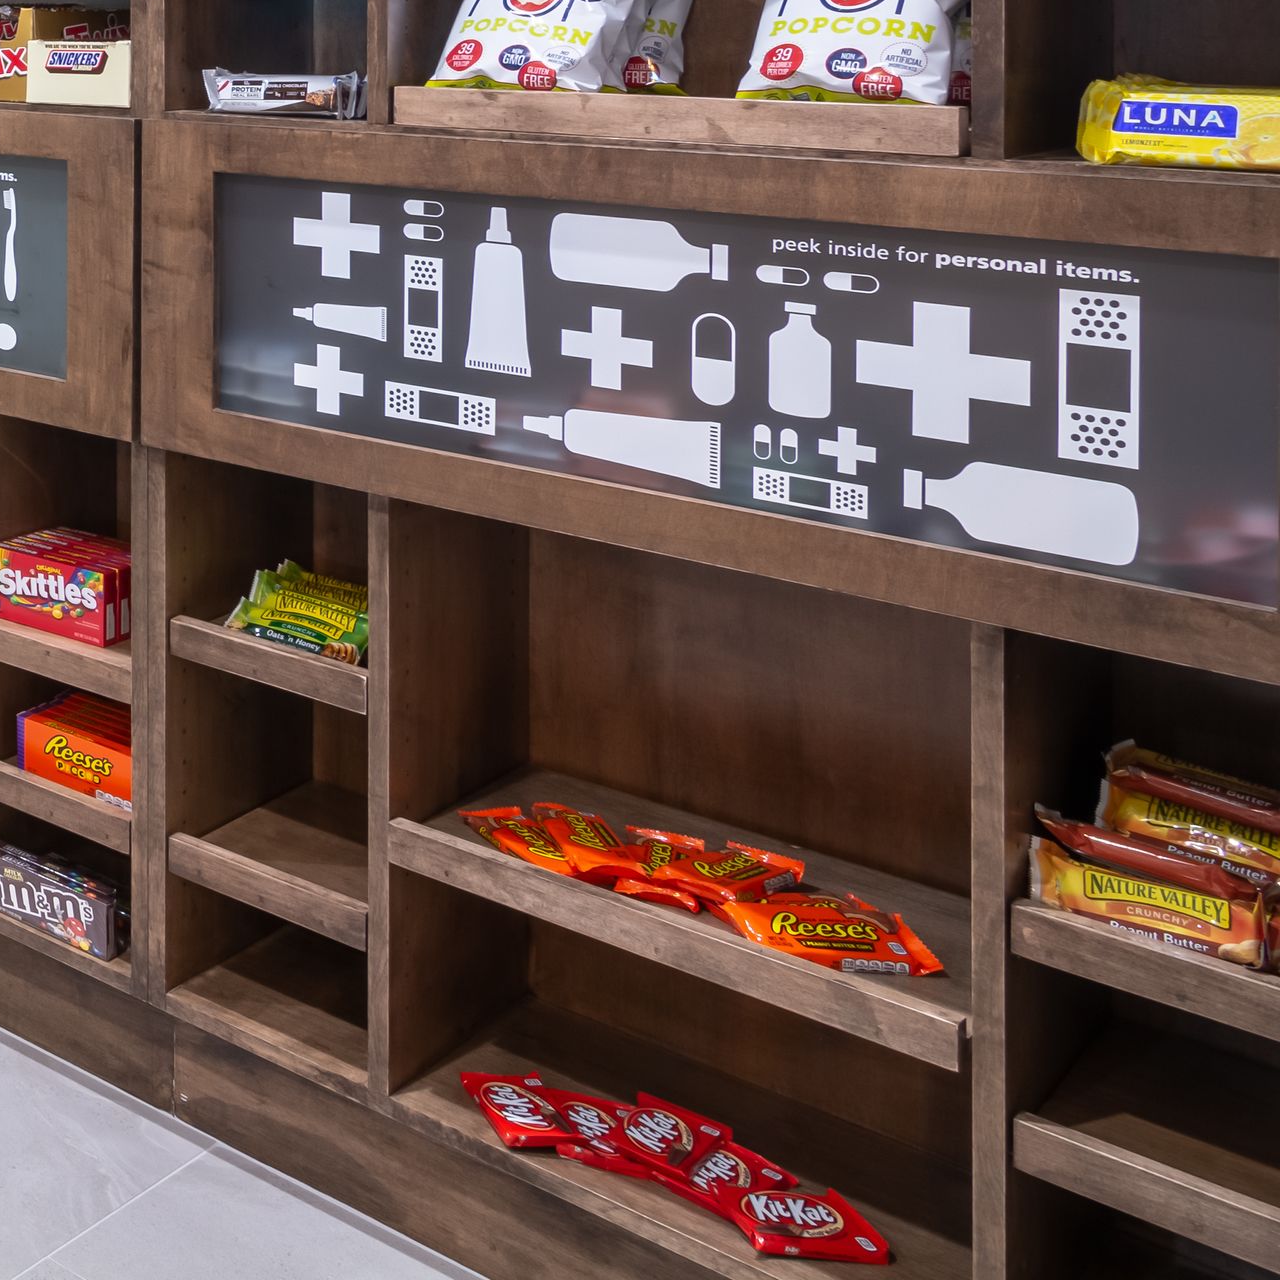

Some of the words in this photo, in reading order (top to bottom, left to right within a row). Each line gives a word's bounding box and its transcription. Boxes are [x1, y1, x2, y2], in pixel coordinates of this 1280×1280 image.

[460, 18, 593, 46] POPCORN
[769, 17, 936, 44] POPCORN
[458, 43, 473, 54] 39
[773, 48, 792, 61] 39
[49, 52, 101, 67] SNICKERS
[502, 53, 525, 66] GMO
[547, 53, 576, 64] ARTIFICIAL
[840, 52, 855, 60] NON
[885, 55, 924, 67] ARTIFICIAL
[527, 66, 549, 75] GLUTEN
[767, 61, 792, 69] CALORIES
[767, 68, 778, 76] PER
[831, 59, 860, 73] GMO
[524, 74, 551, 88] FREE
[864, 74, 893, 84] GLUTEN
[860, 82, 895, 97] FREE
[1124, 107, 1225, 128] LUNA
[772, 236, 821, 254] peek
[828, 240, 889, 261] inside
[896, 246, 929, 263] for
[935, 252, 1046, 276] personal
[1056, 260, 1140, 284] items.
[36, 565, 62, 575] ORIGINAL
[280, 596, 316, 614] NATURE
[320, 607, 355, 630] VALLEY
[282, 623, 316, 637] CRUNCHY
[267, 629, 284, 640] Oats
[296, 636, 320, 652] Honey
[45, 735, 113, 775] Reese's
[1156, 799, 1223, 832] NATURE
[693, 853, 757, 878] Reese's
[1167, 845, 1215, 865] Peanut
[1221, 861, 1267, 881] Butter
[4, 868, 22, 877] MILK
[1091, 874, 1157, 900] NATURE
[1160, 889, 1224, 923] VALLEY
[1127, 907, 1189, 926] CRUNCHY
[770, 912, 879, 941] Reese's
[1110, 921, 1158, 940] Peanut
[1164, 933, 1209, 952] Butter
[807, 941, 831, 949] PEANUT
